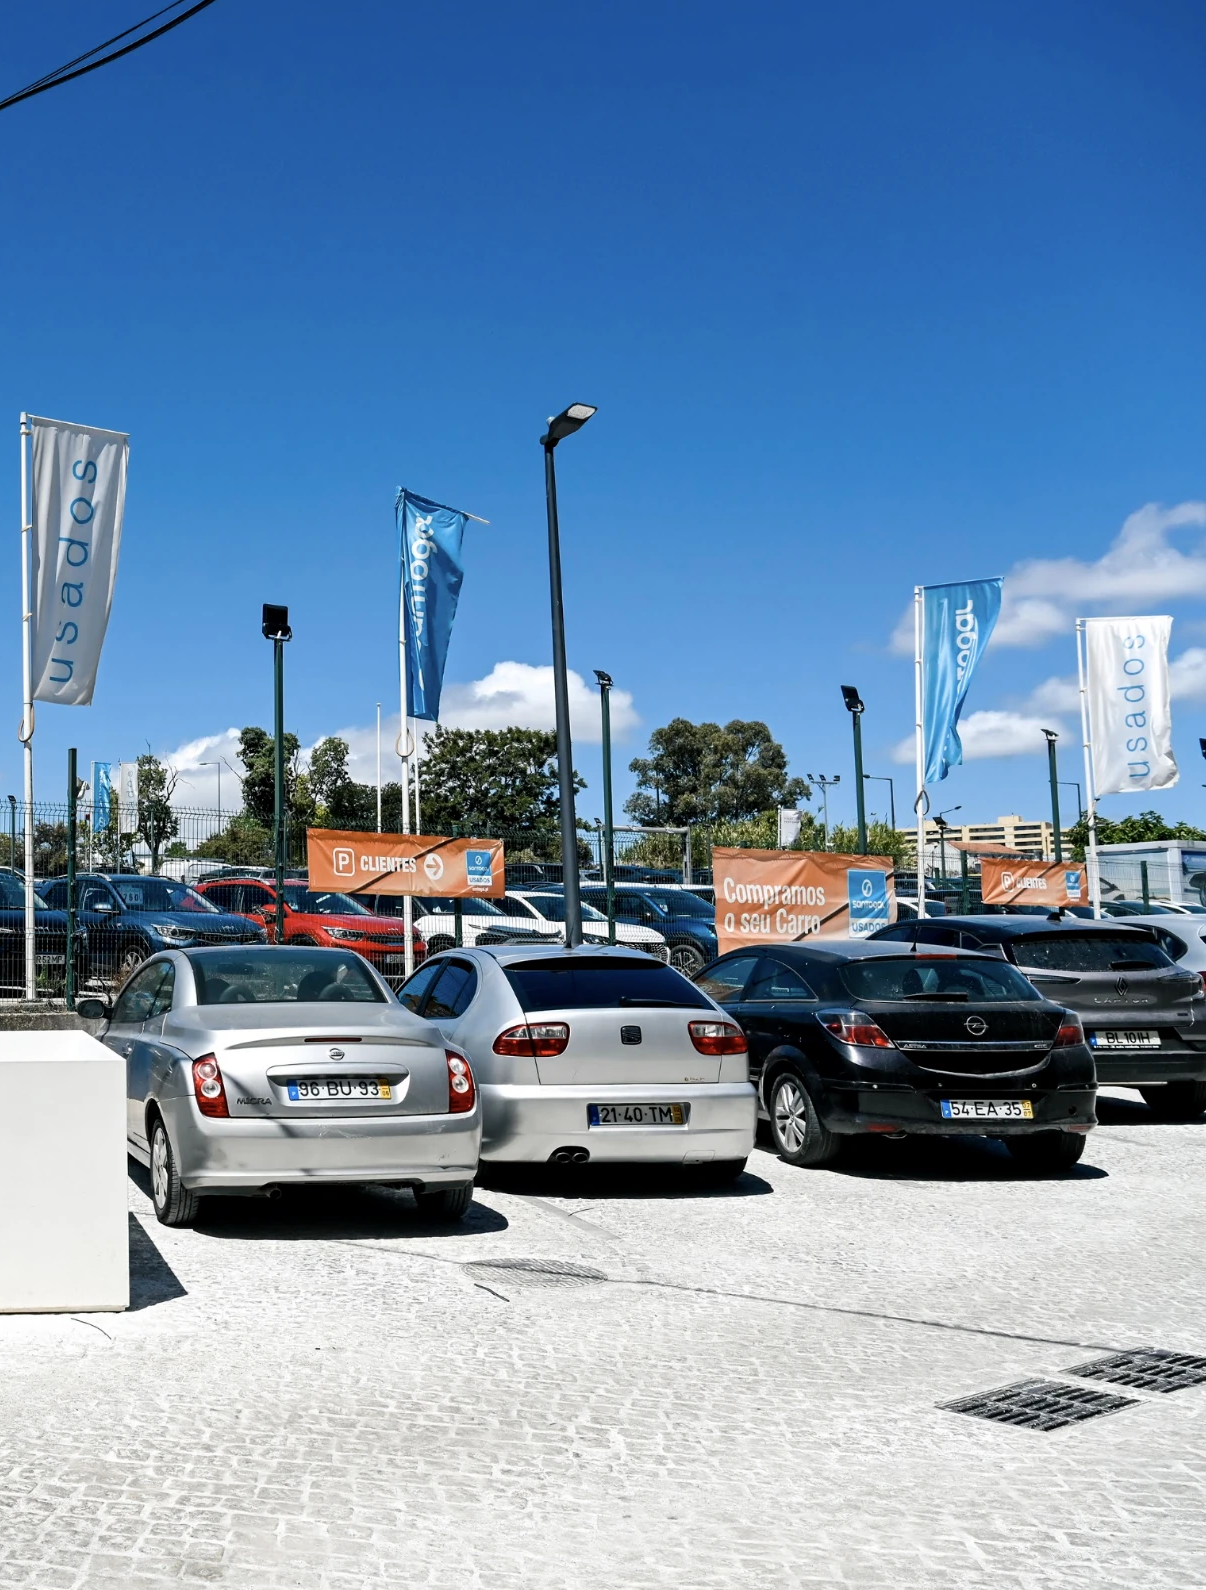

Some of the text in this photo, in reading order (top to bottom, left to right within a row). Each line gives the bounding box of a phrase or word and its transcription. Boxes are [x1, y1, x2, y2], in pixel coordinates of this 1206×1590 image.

[49, 459, 98, 683] usados
[1117, 634, 1151, 780] usados
[360, 855, 417, 873] CLIENTES
[723, 877, 826, 910] Compramos
[724, 908, 821, 935] o seu Carro
